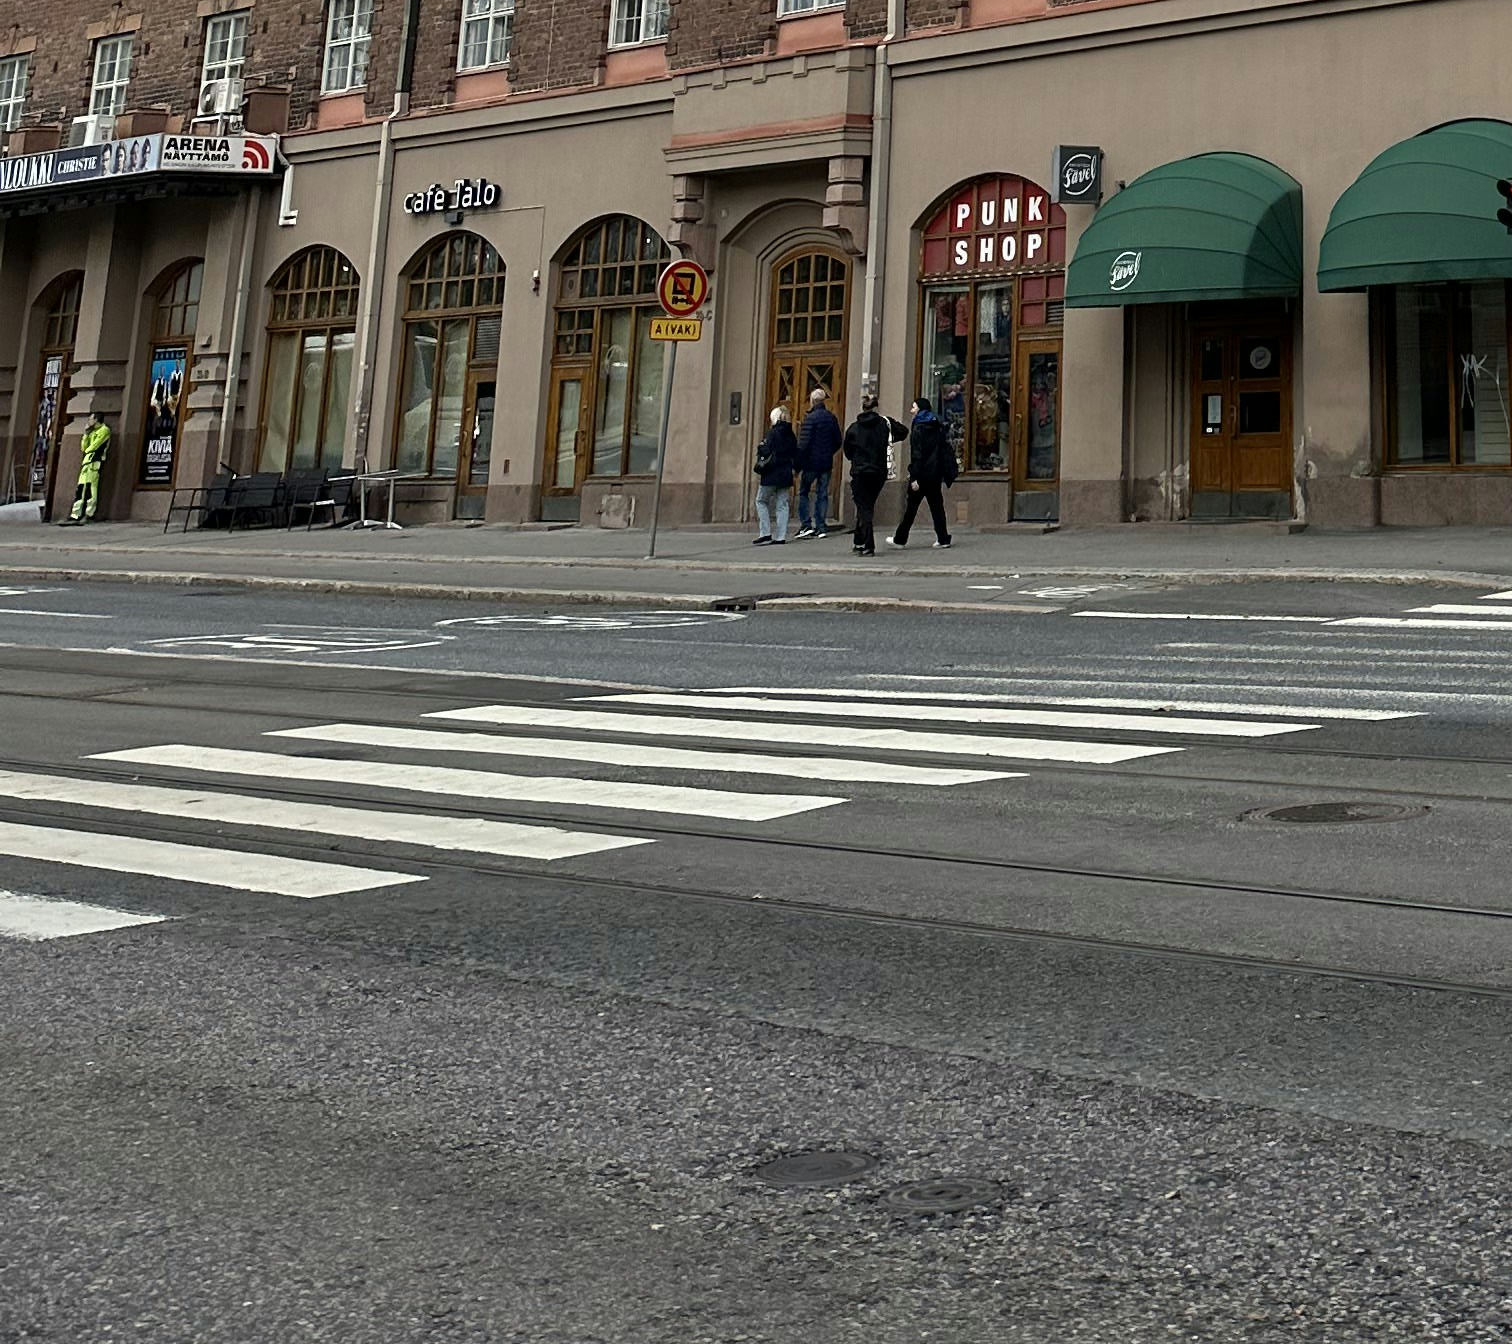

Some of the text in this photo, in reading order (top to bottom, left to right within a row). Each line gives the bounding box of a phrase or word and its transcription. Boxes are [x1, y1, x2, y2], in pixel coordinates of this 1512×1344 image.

[165, 137, 231, 152] ARENA
[57, 156, 98, 175] CHRISTIE
[163, 151, 230, 162] NÄYTTÄMÖ
[448, 178, 497, 209] Talo
[956, 195, 1043, 229] PUNK
[954, 233, 1042, 266] SHOP
[655, 322, 697, 336] A (VAK)
